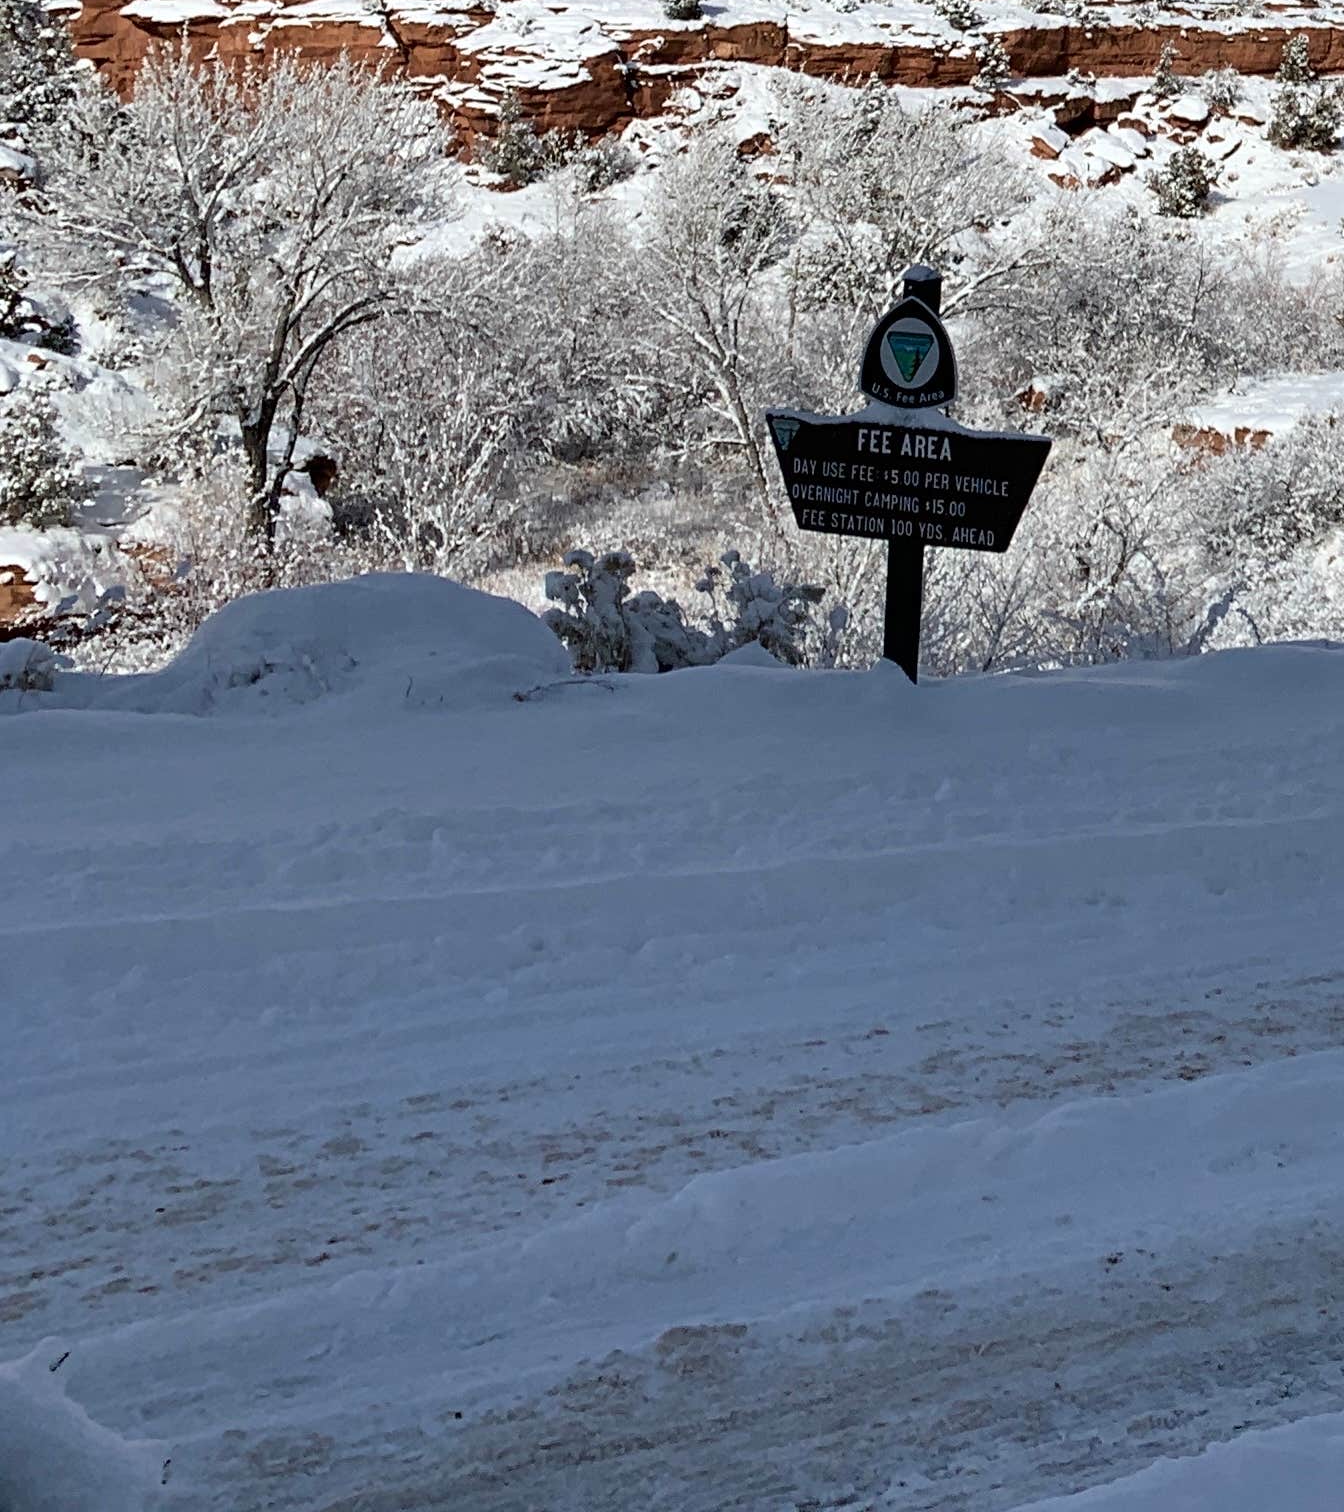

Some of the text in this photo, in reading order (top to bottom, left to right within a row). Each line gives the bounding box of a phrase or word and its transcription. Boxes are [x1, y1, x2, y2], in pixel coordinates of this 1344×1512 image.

[872, 382, 945, 404] U.S. Fee Area
[858, 428, 952, 461] FEE AREA
[793, 457, 817, 475] DAY
[822, 461, 846, 478] USE
[925, 472, 950, 490] PER
[955, 475, 1009, 497] VEHICLE
[792, 483, 966, 517] OVERNIGHT CAMPING $15.00
[802, 508, 826, 527] FEE
[831, 512, 885, 534] STATION
[891, 519, 913, 537] 100
[952, 527, 995, 547] AHEAD
